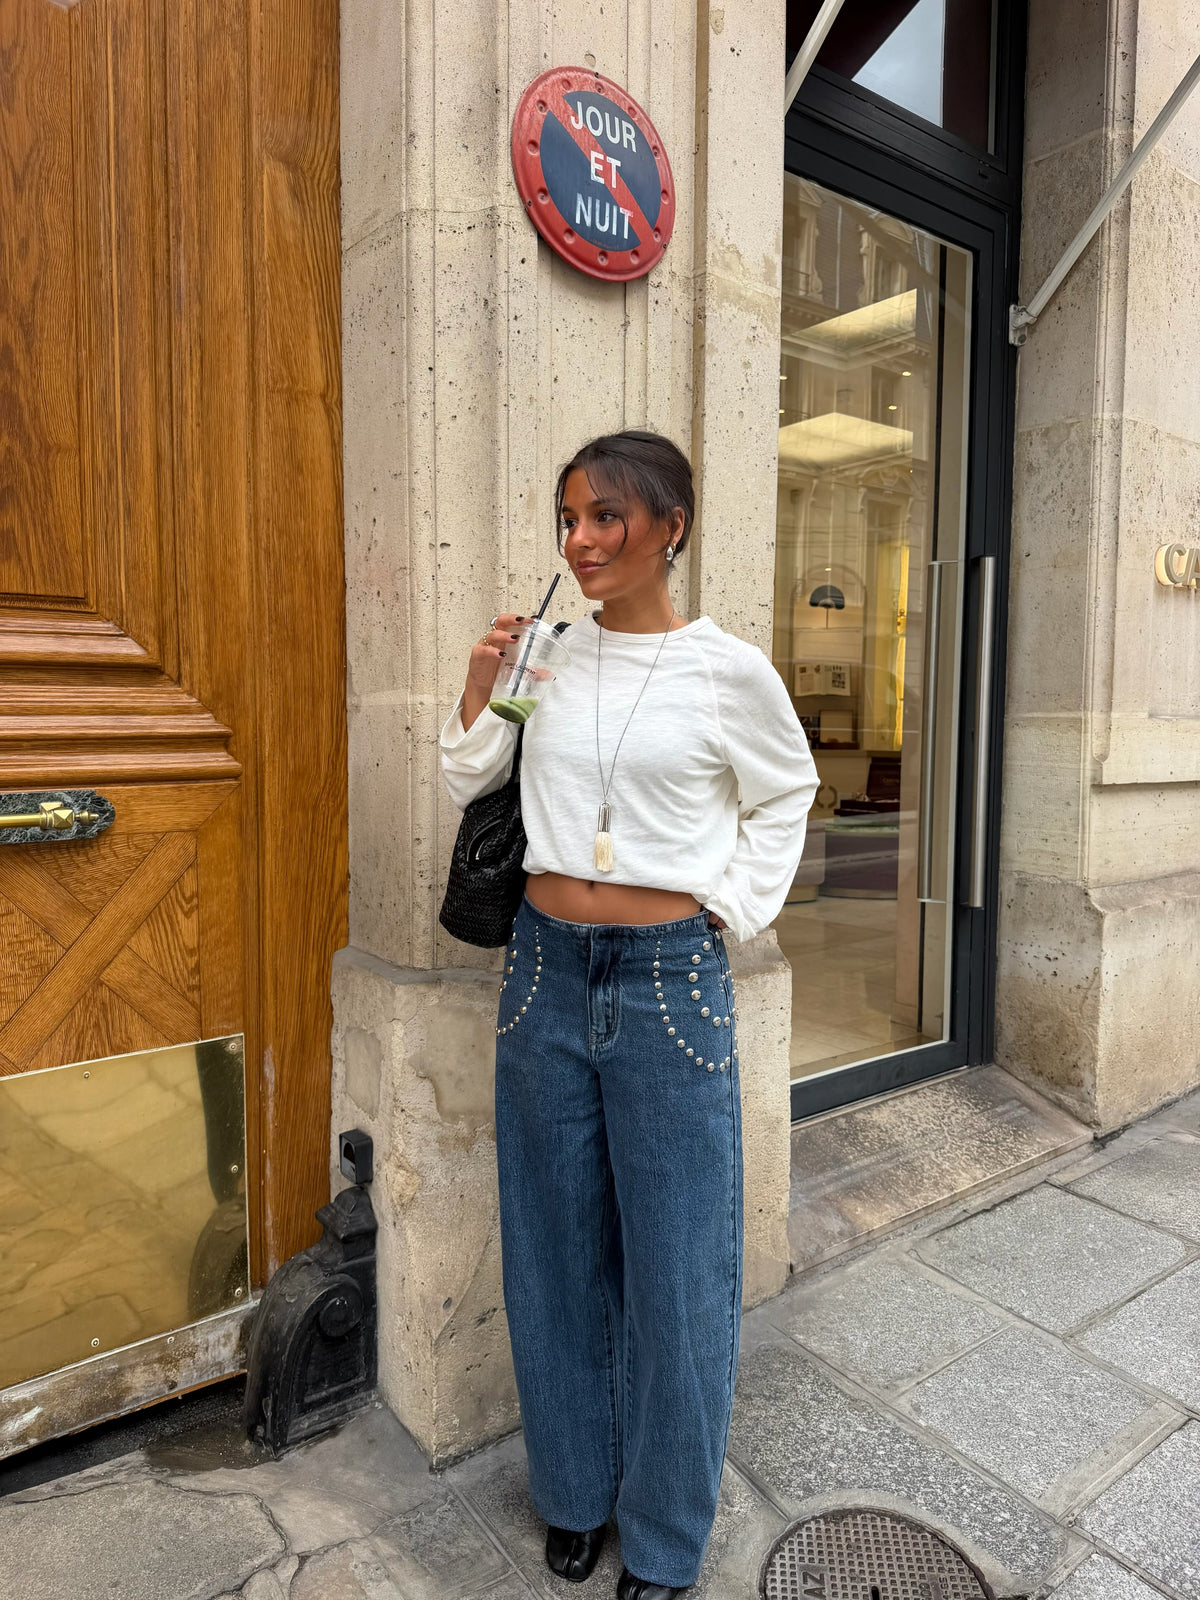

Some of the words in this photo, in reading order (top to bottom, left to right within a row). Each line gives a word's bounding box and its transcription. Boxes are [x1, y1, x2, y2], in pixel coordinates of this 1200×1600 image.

[570, 101, 636, 152] JOUR
[590, 150, 621, 188] ET
[575, 193, 634, 239] NUIT
